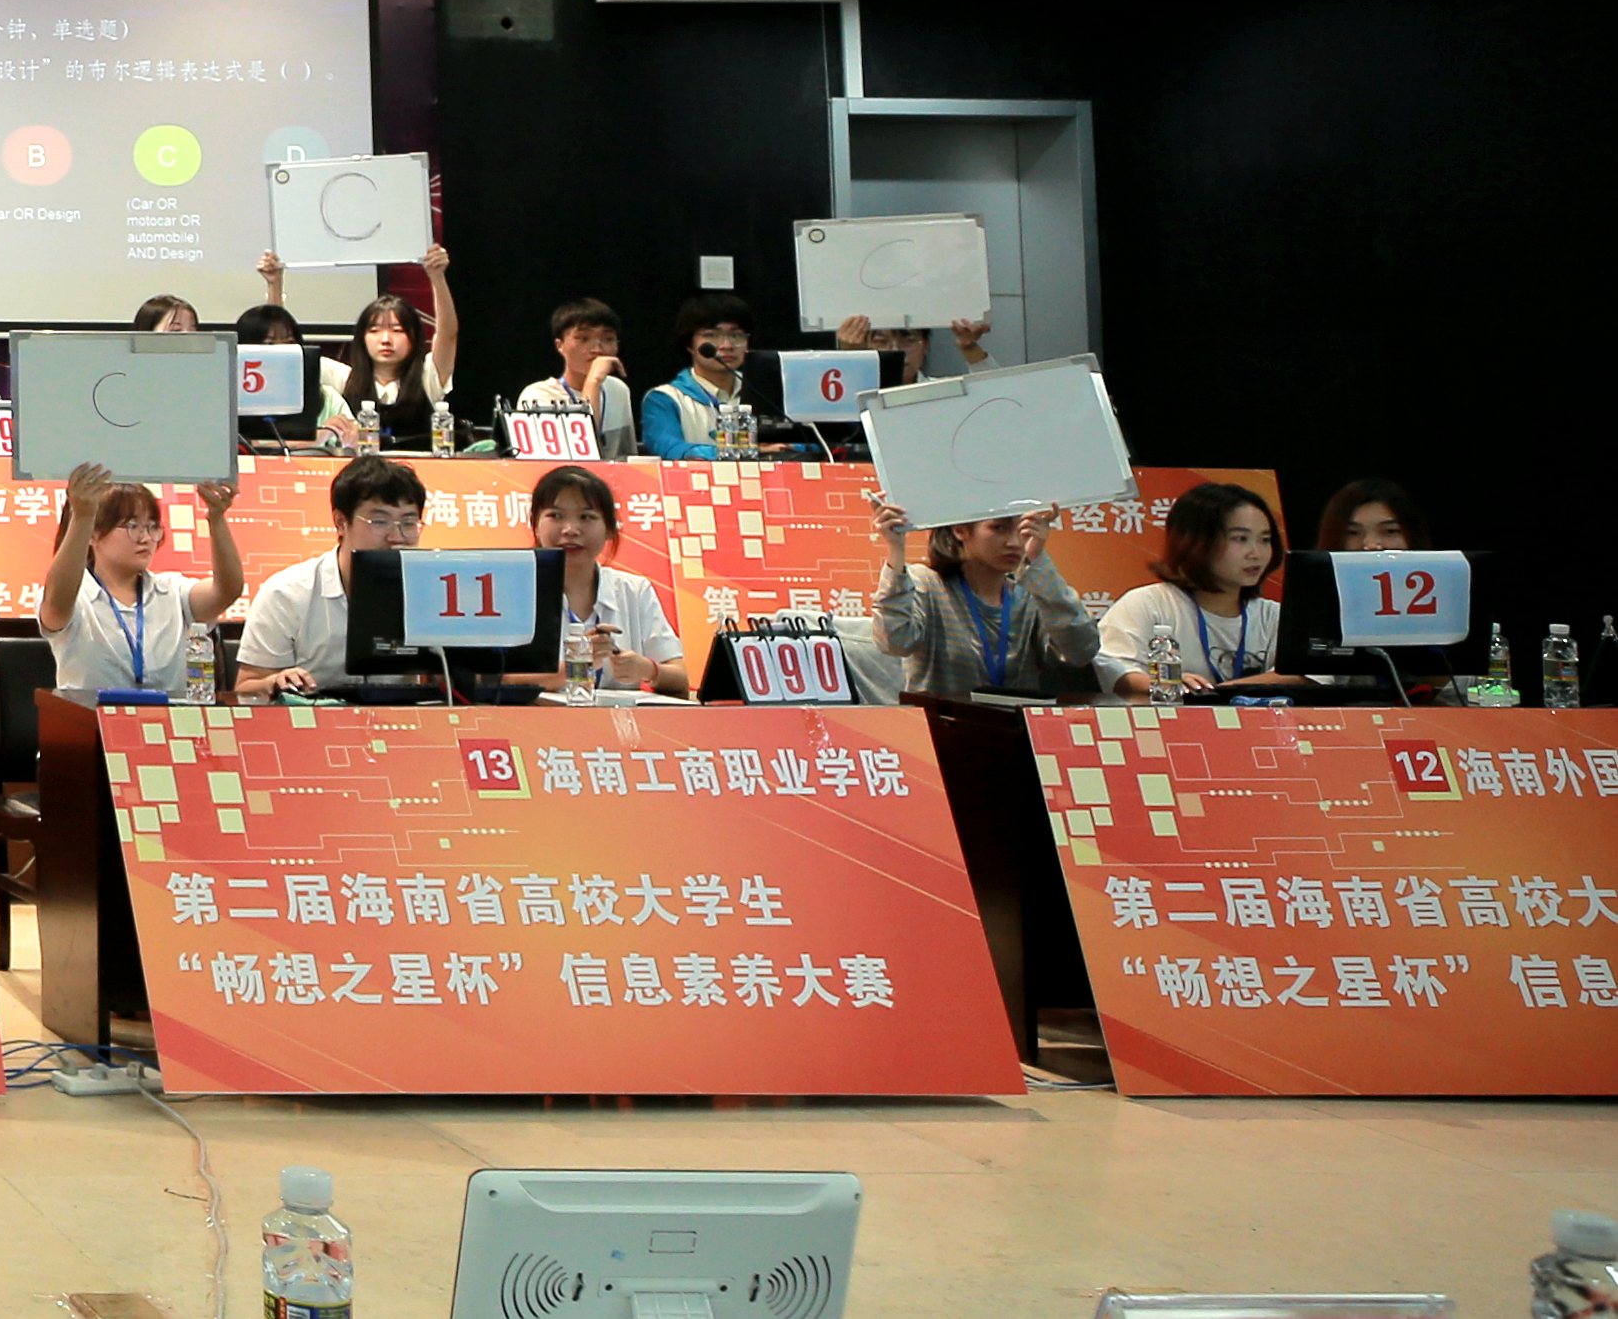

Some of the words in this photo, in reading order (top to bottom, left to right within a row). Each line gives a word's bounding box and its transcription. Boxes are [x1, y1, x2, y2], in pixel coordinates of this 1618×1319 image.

[27, 145, 46, 168] B
[157, 145, 177, 169] C
[13, 207, 35, 221] OR
[37, 207, 81, 224] Design
[126, 197, 154, 212] (Car
[156, 197, 178, 211] OR
[179, 214, 201, 228] OR
[320, 172, 383, 241] C
[127, 247, 158, 261] AND
[160, 247, 204, 263] Design
[241, 361, 265, 394] 5
[820, 368, 844, 402] 6
[92, 372, 142, 428] C
[514, 419, 591, 455] 093
[951, 396, 1024, 484] C
[438, 571, 503, 619] 11
[1372, 571, 1439, 617] 12
[742, 642, 840, 696] 090
[468, 749, 515, 782] 13
[537, 746, 912, 799] 海南工商职业学院
[1394, 750, 1445, 782] 12
[165, 873, 794, 928] 第二届海南省高校大学生
